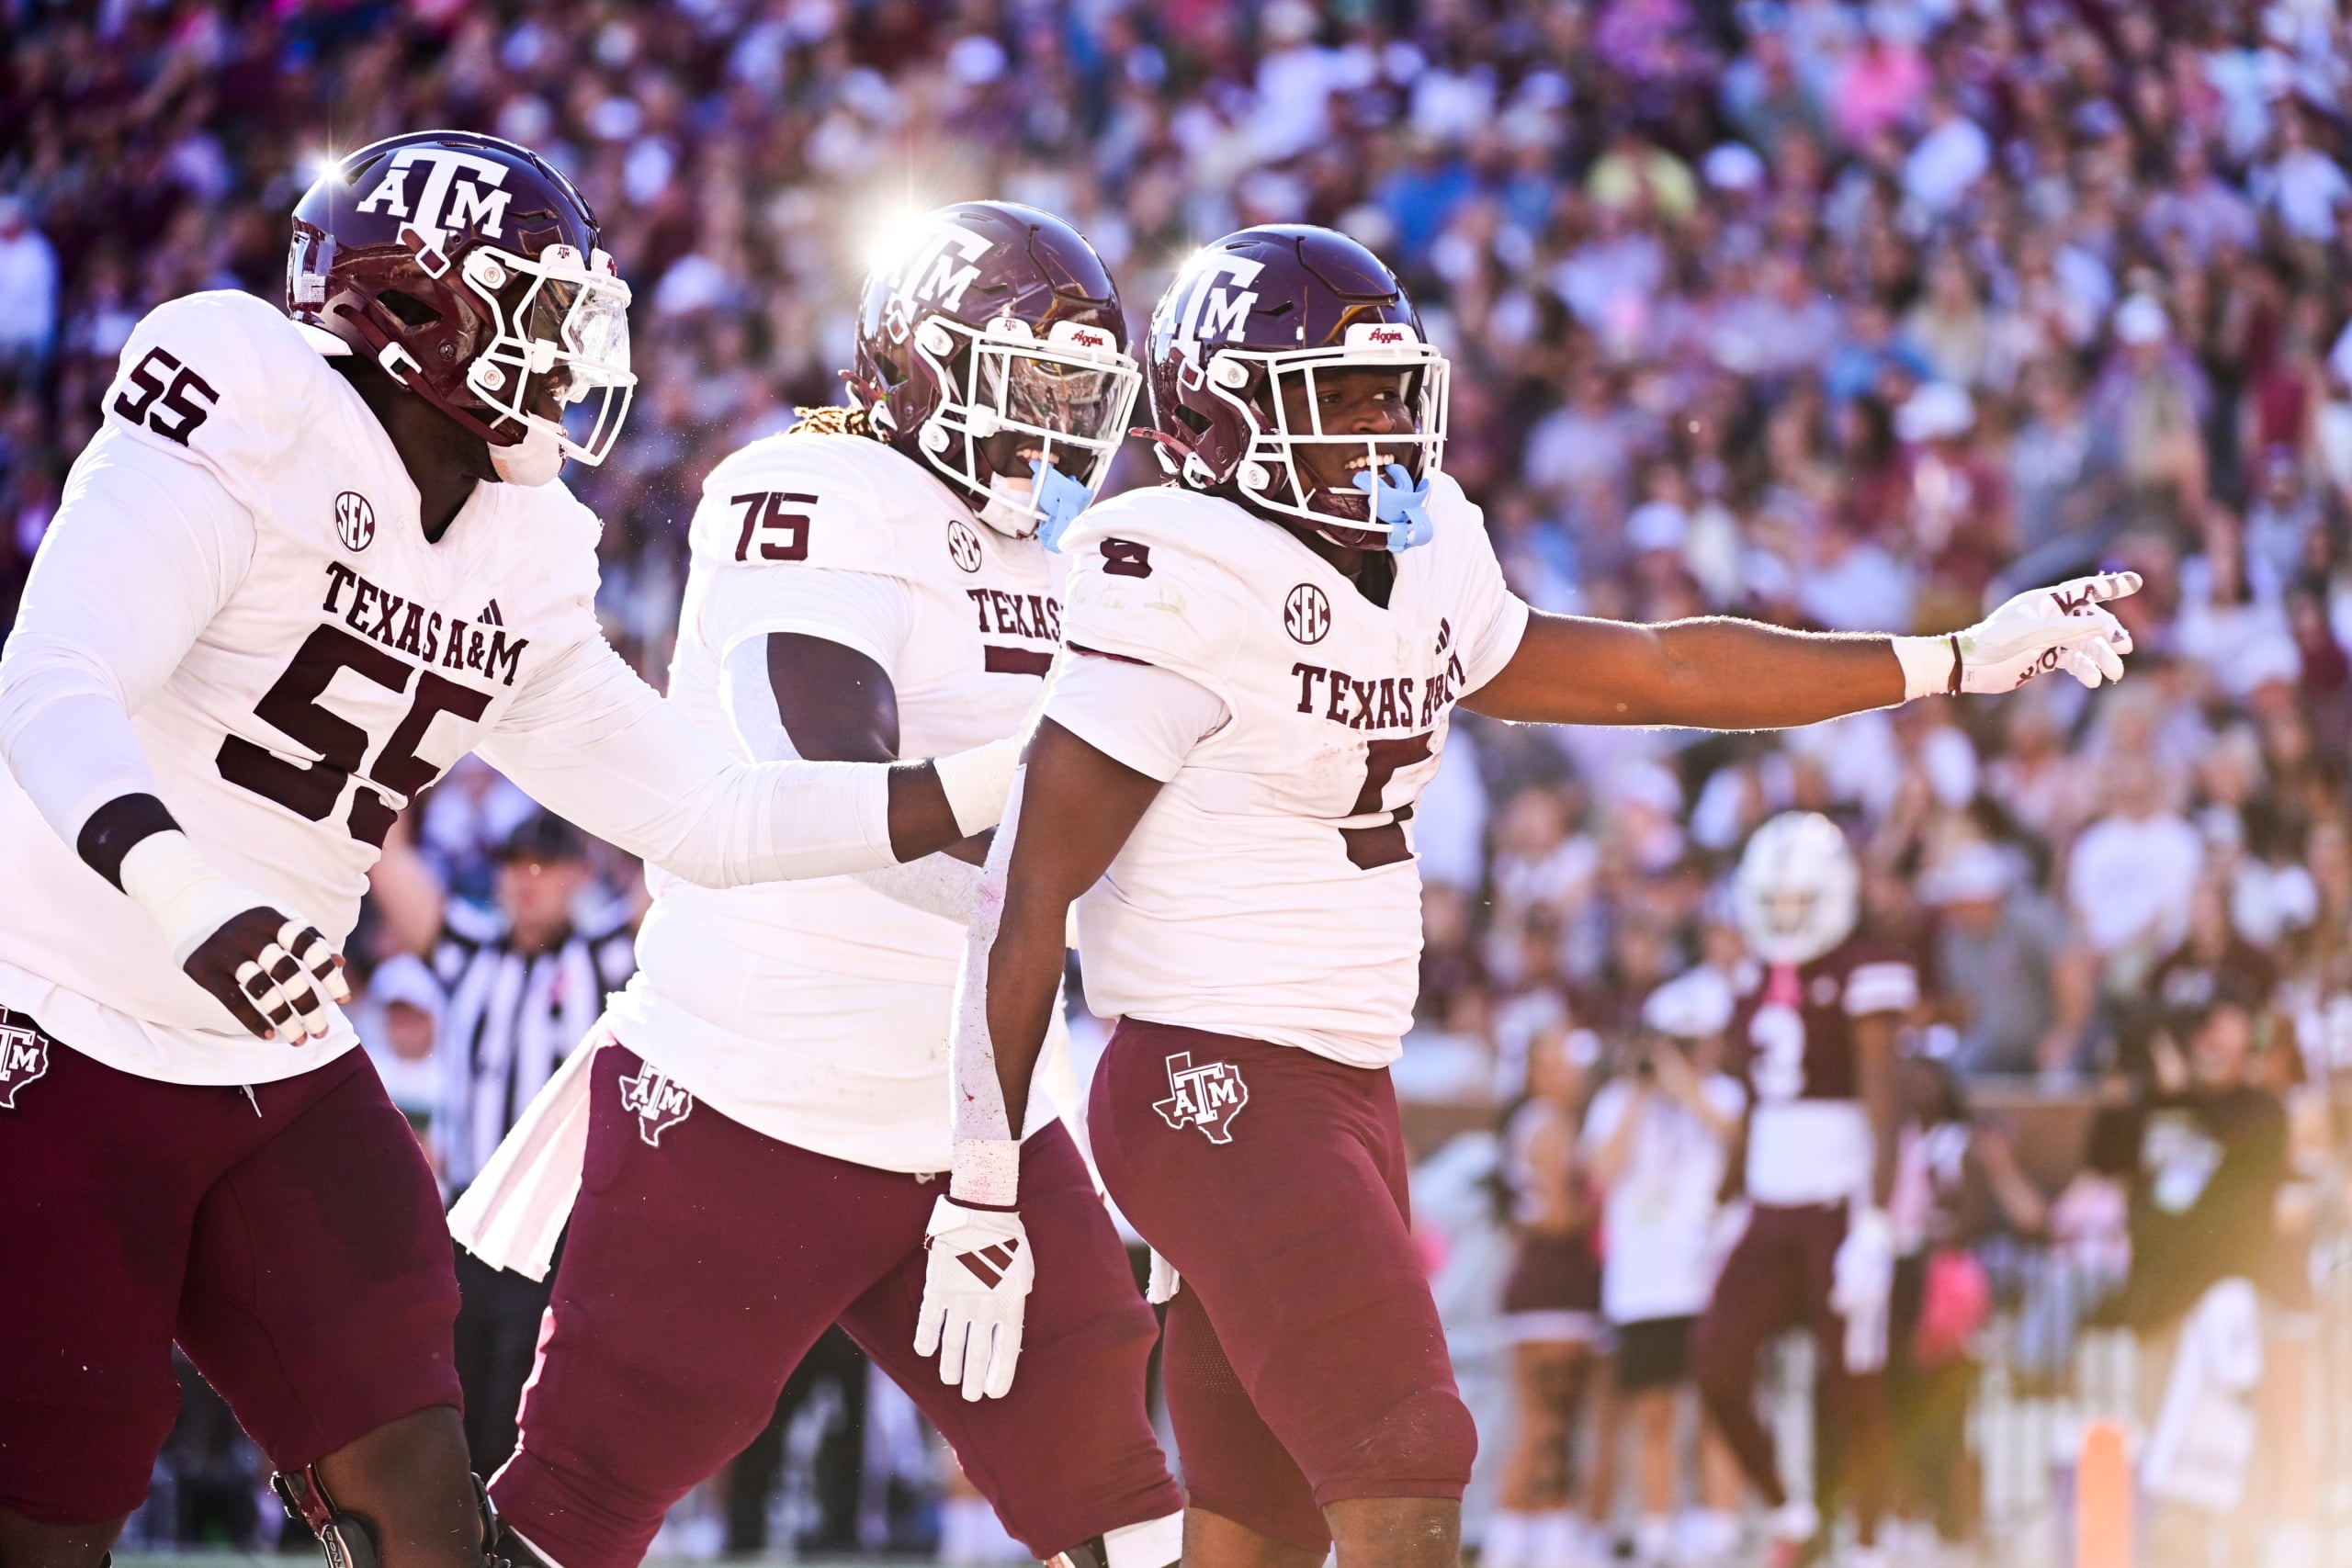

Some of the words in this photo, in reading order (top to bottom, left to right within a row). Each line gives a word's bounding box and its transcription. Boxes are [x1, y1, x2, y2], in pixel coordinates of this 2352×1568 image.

[356, 148, 513, 254] ATM
[1369, 327, 1404, 344] Aggies
[114, 345, 220, 447] 55
[335, 492, 374, 550] SEC
[730, 491, 820, 561] 75
[948, 521, 981, 571] SEC
[322, 560, 443, 663] TEXAS
[442, 618, 530, 687] A&M
[966, 588, 1061, 643] TEXAS
[1285, 585, 1329, 642] SEC
[1291, 661, 1415, 730] TEXAS
[215, 622, 494, 851] 55
[1338, 730, 1434, 871] 5
[0, 1022, 40, 1081] TM
[1173, 1062, 1238, 1124] ATM
